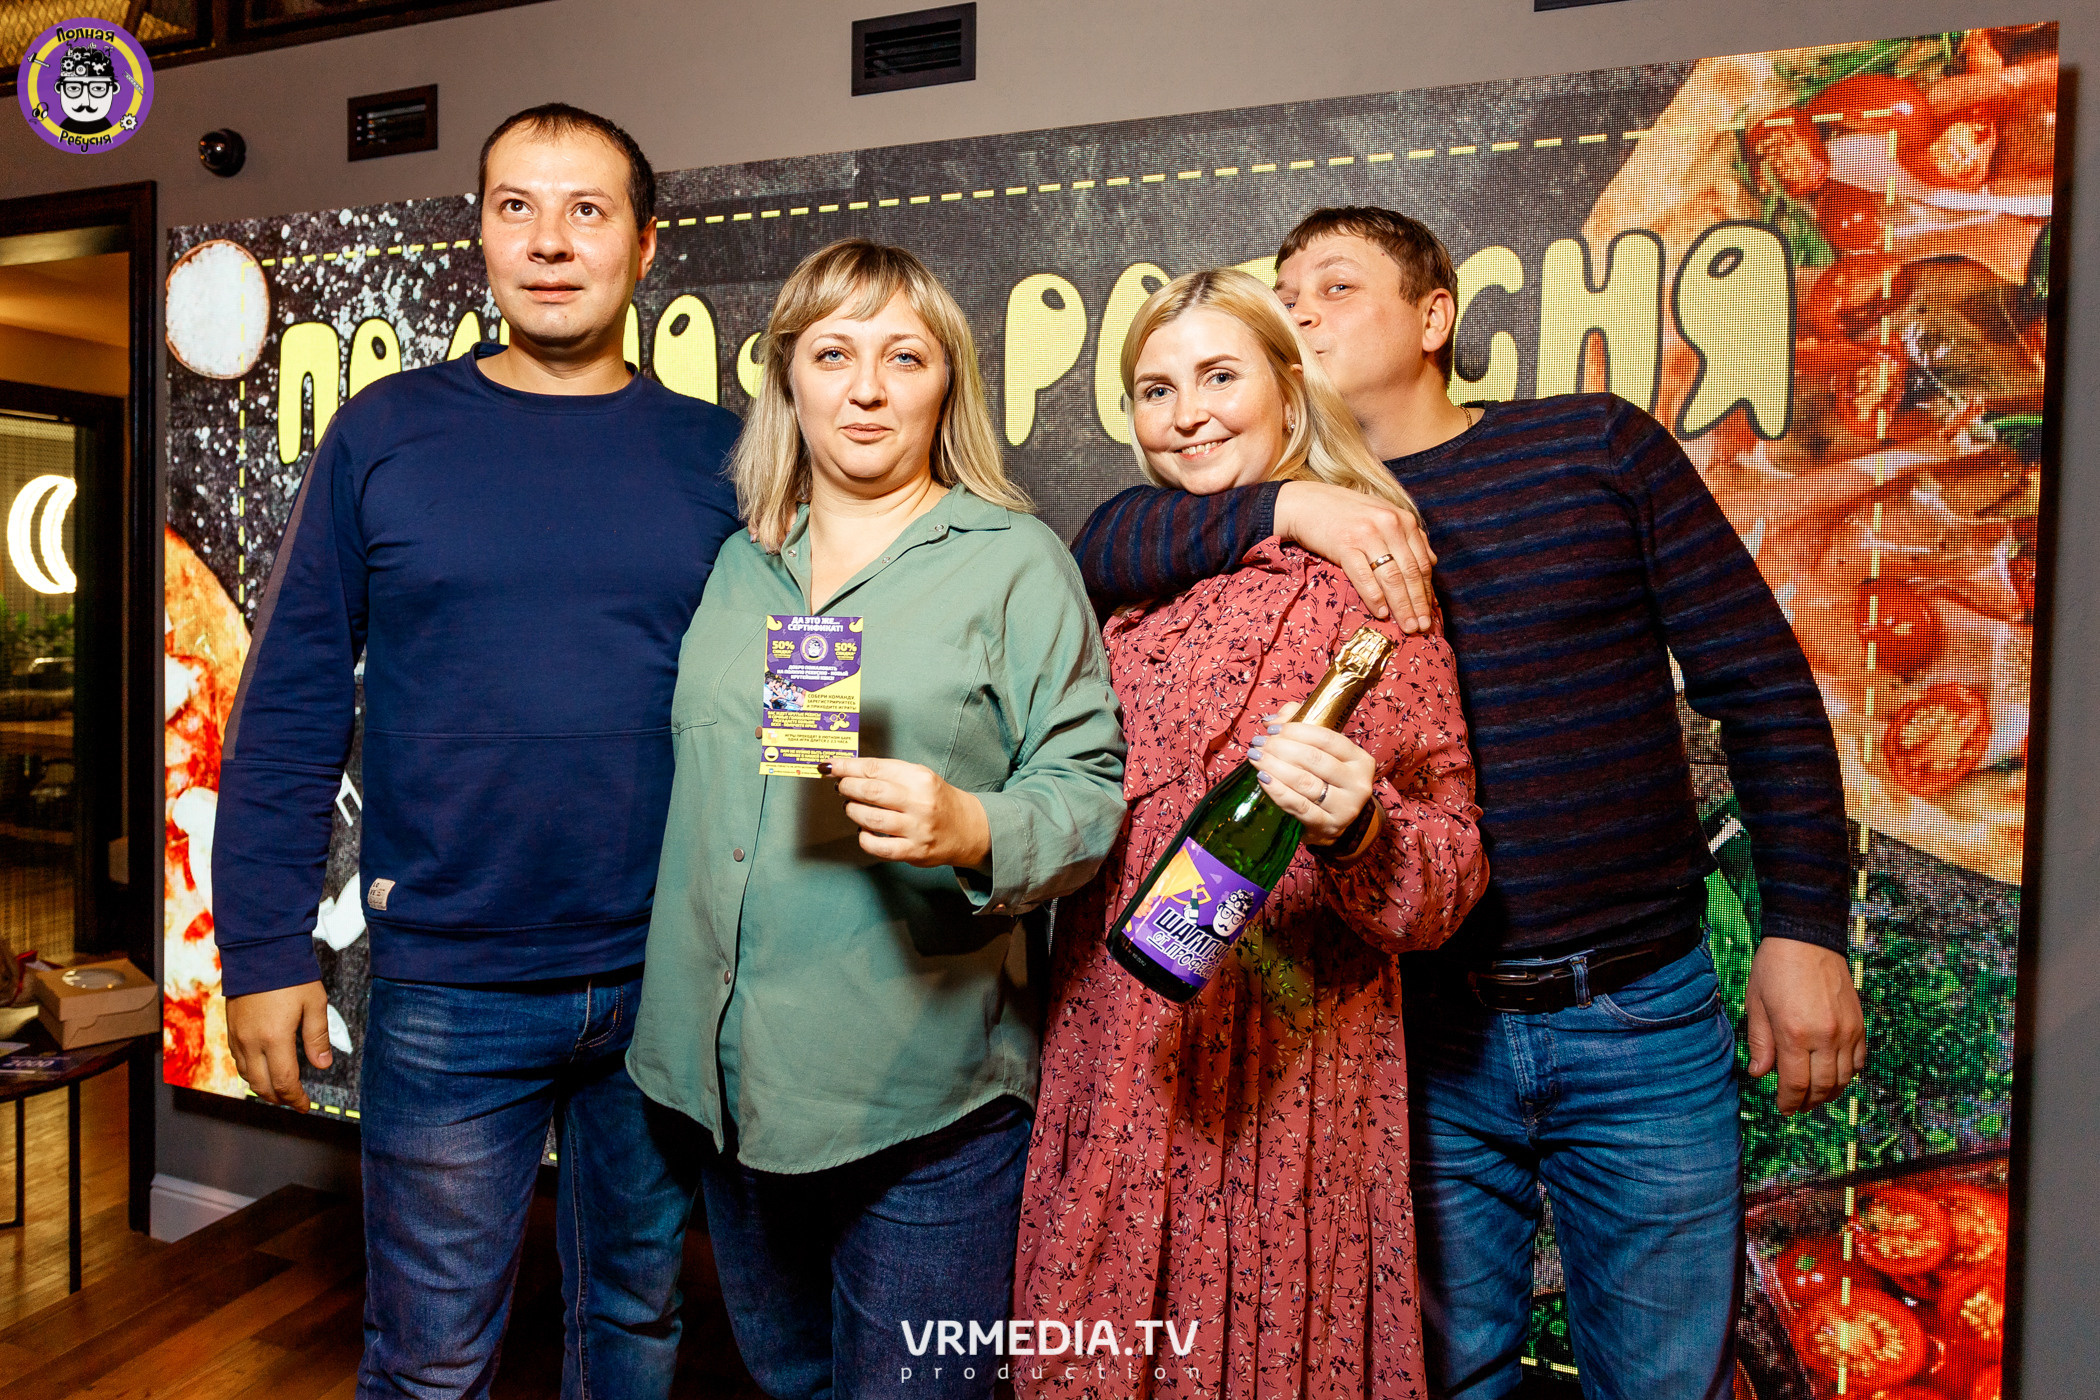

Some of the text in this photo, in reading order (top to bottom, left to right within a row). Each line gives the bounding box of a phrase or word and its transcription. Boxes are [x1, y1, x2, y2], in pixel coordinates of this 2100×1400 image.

[792, 616, 804, 624] ДА
[788, 624, 844, 632] СЕРТИФИКАТ!
[772, 640, 858, 652] 50% 50%
[1153, 930, 1170, 947] ОТ
